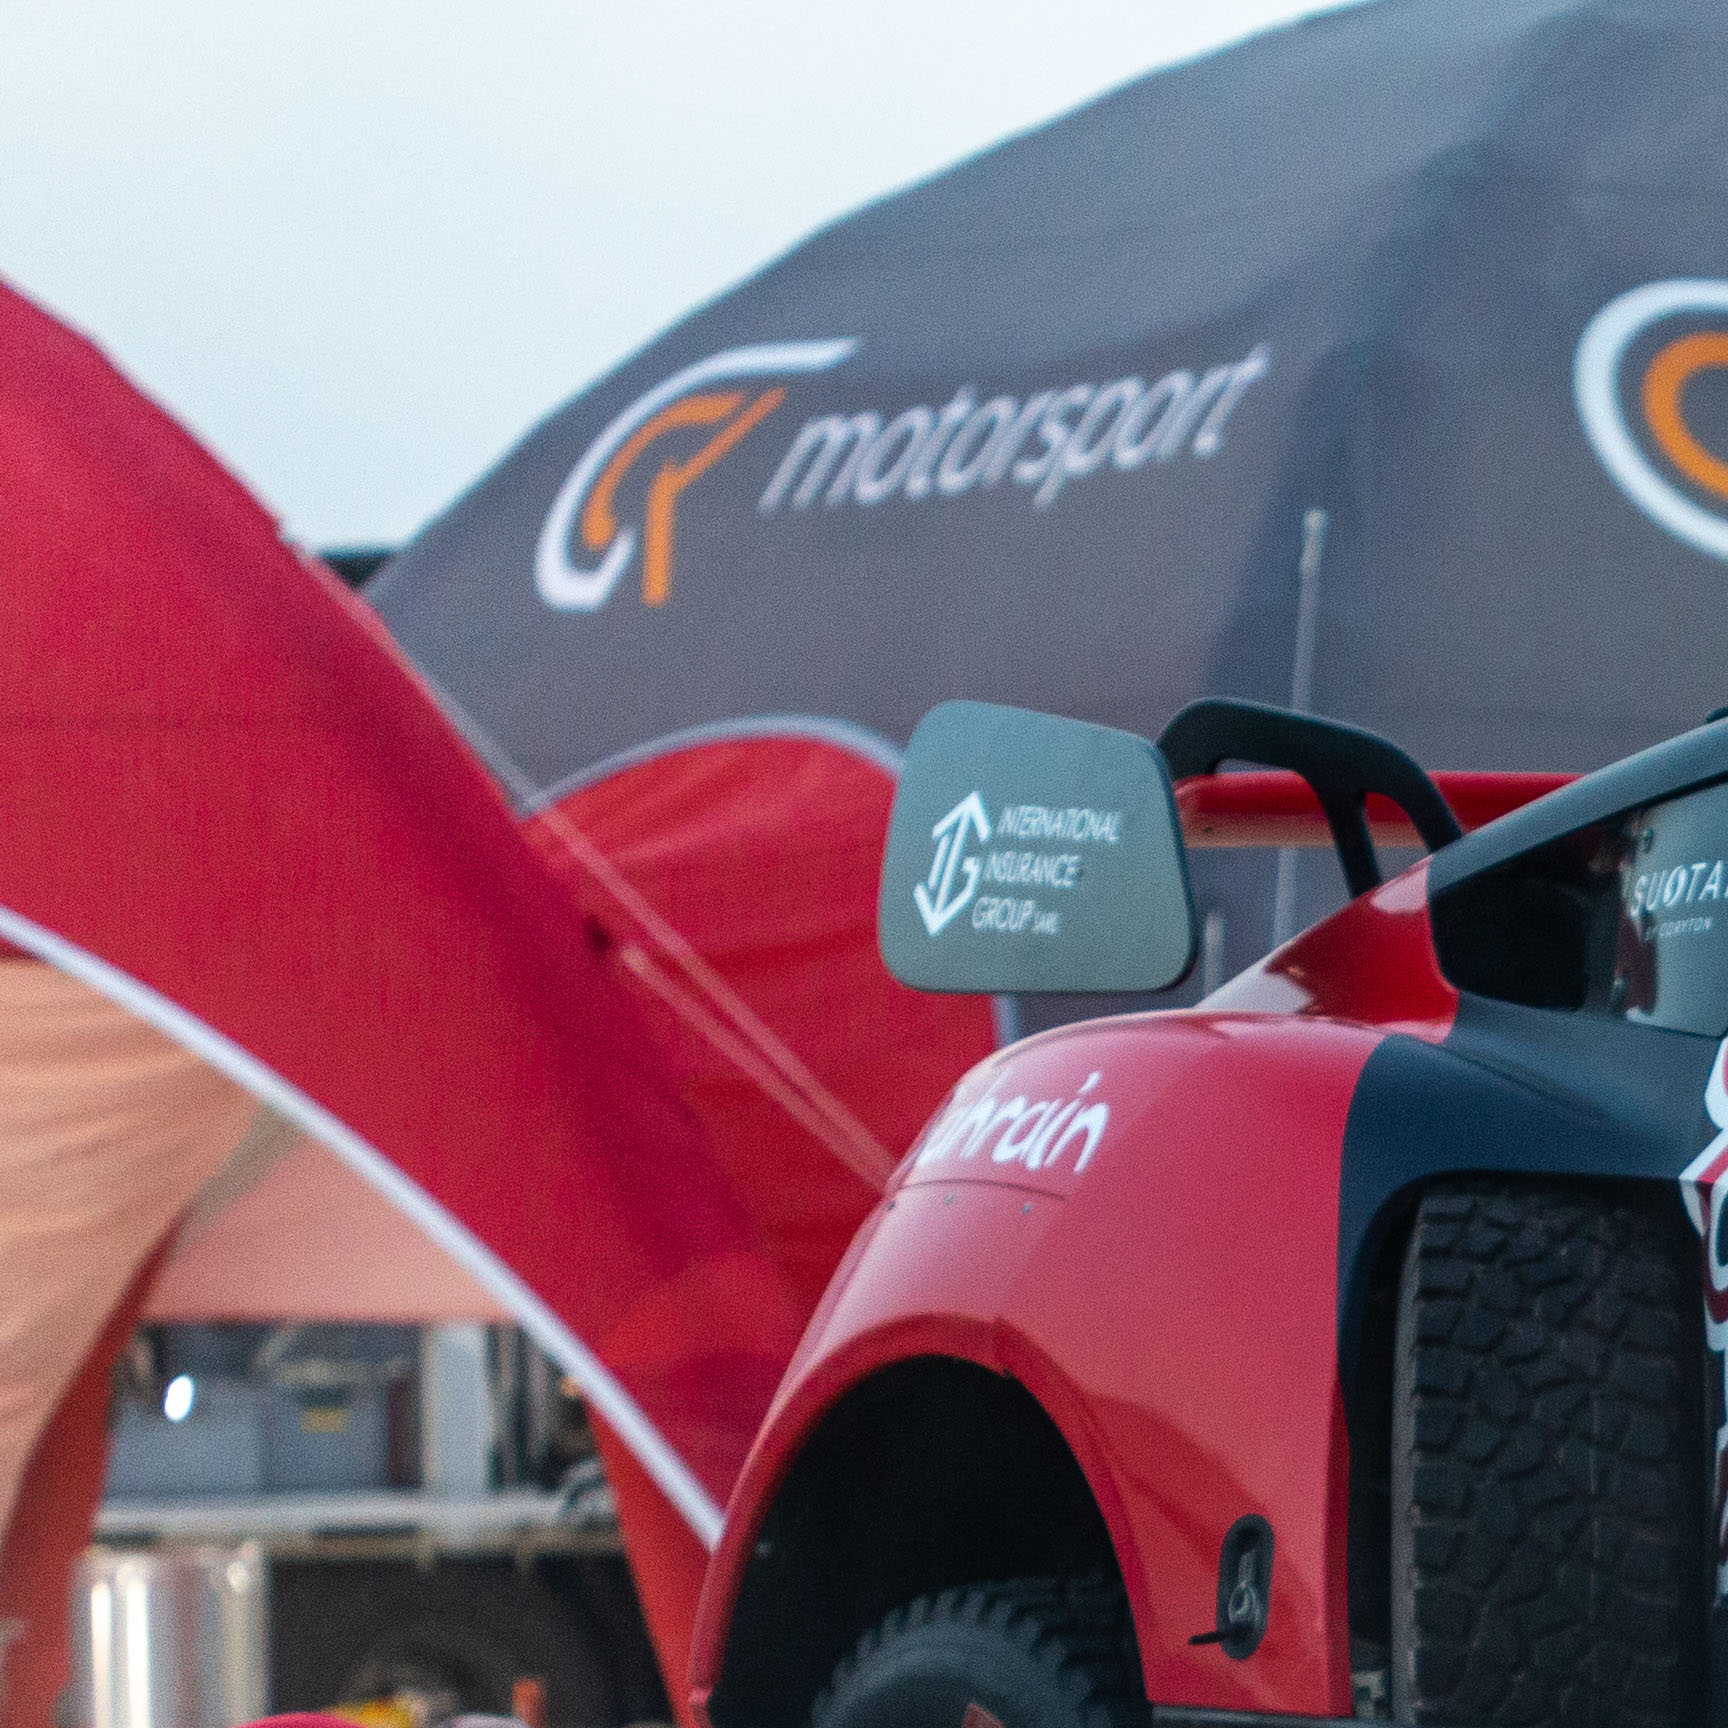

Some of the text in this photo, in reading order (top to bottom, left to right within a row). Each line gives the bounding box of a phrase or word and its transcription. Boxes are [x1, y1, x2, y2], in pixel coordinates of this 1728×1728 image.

[757, 343, 1271, 516] motorsport
[997, 805, 1122, 844] INTERNATIONAL
[983, 850, 1083, 888] INSURANCE
[971, 896, 1036, 932] GROUP
